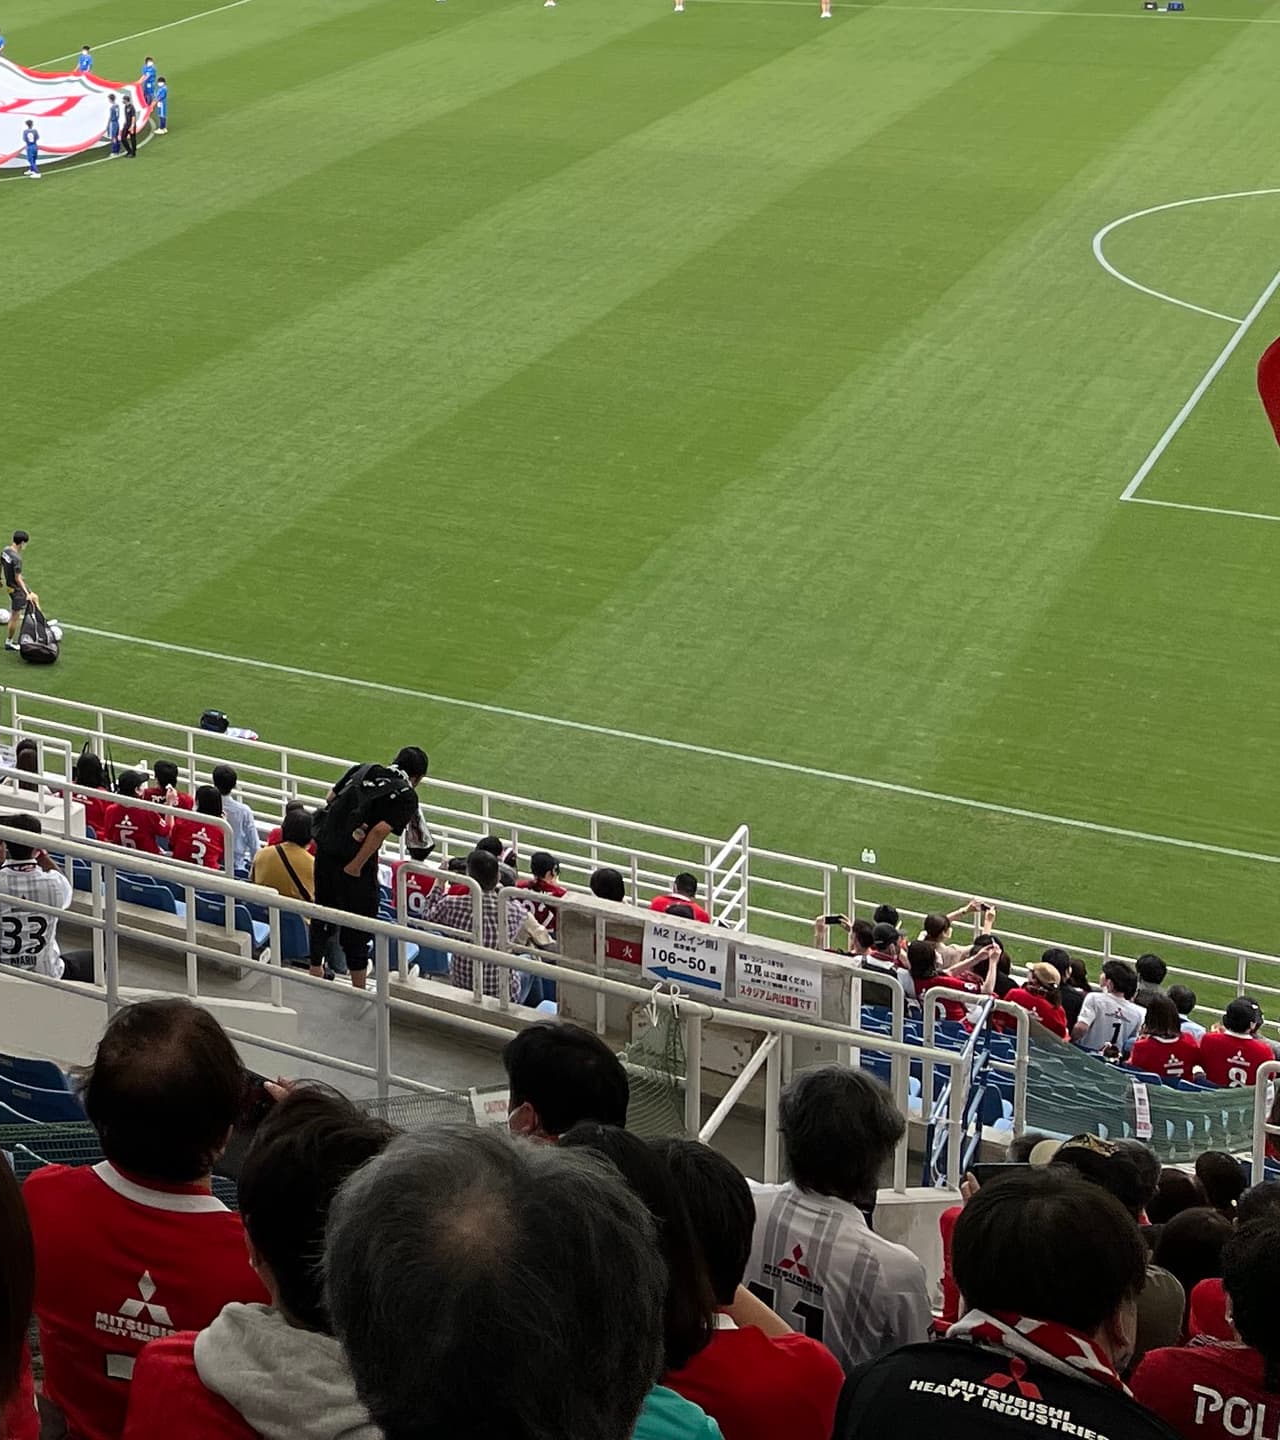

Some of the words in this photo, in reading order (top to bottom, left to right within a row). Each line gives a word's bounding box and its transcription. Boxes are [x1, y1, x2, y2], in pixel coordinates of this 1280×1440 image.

[191, 840, 207, 866] 3
[2, 916, 47, 954] 33
[653, 926, 670, 938] M2
[763, 1263, 824, 1296] MITSUBISHI
[96, 1312, 177, 1337] MITSUBIS
[909, 1379, 976, 1402] HEAVY
[950, 1378, 1071, 1421] MITSUBISHI
